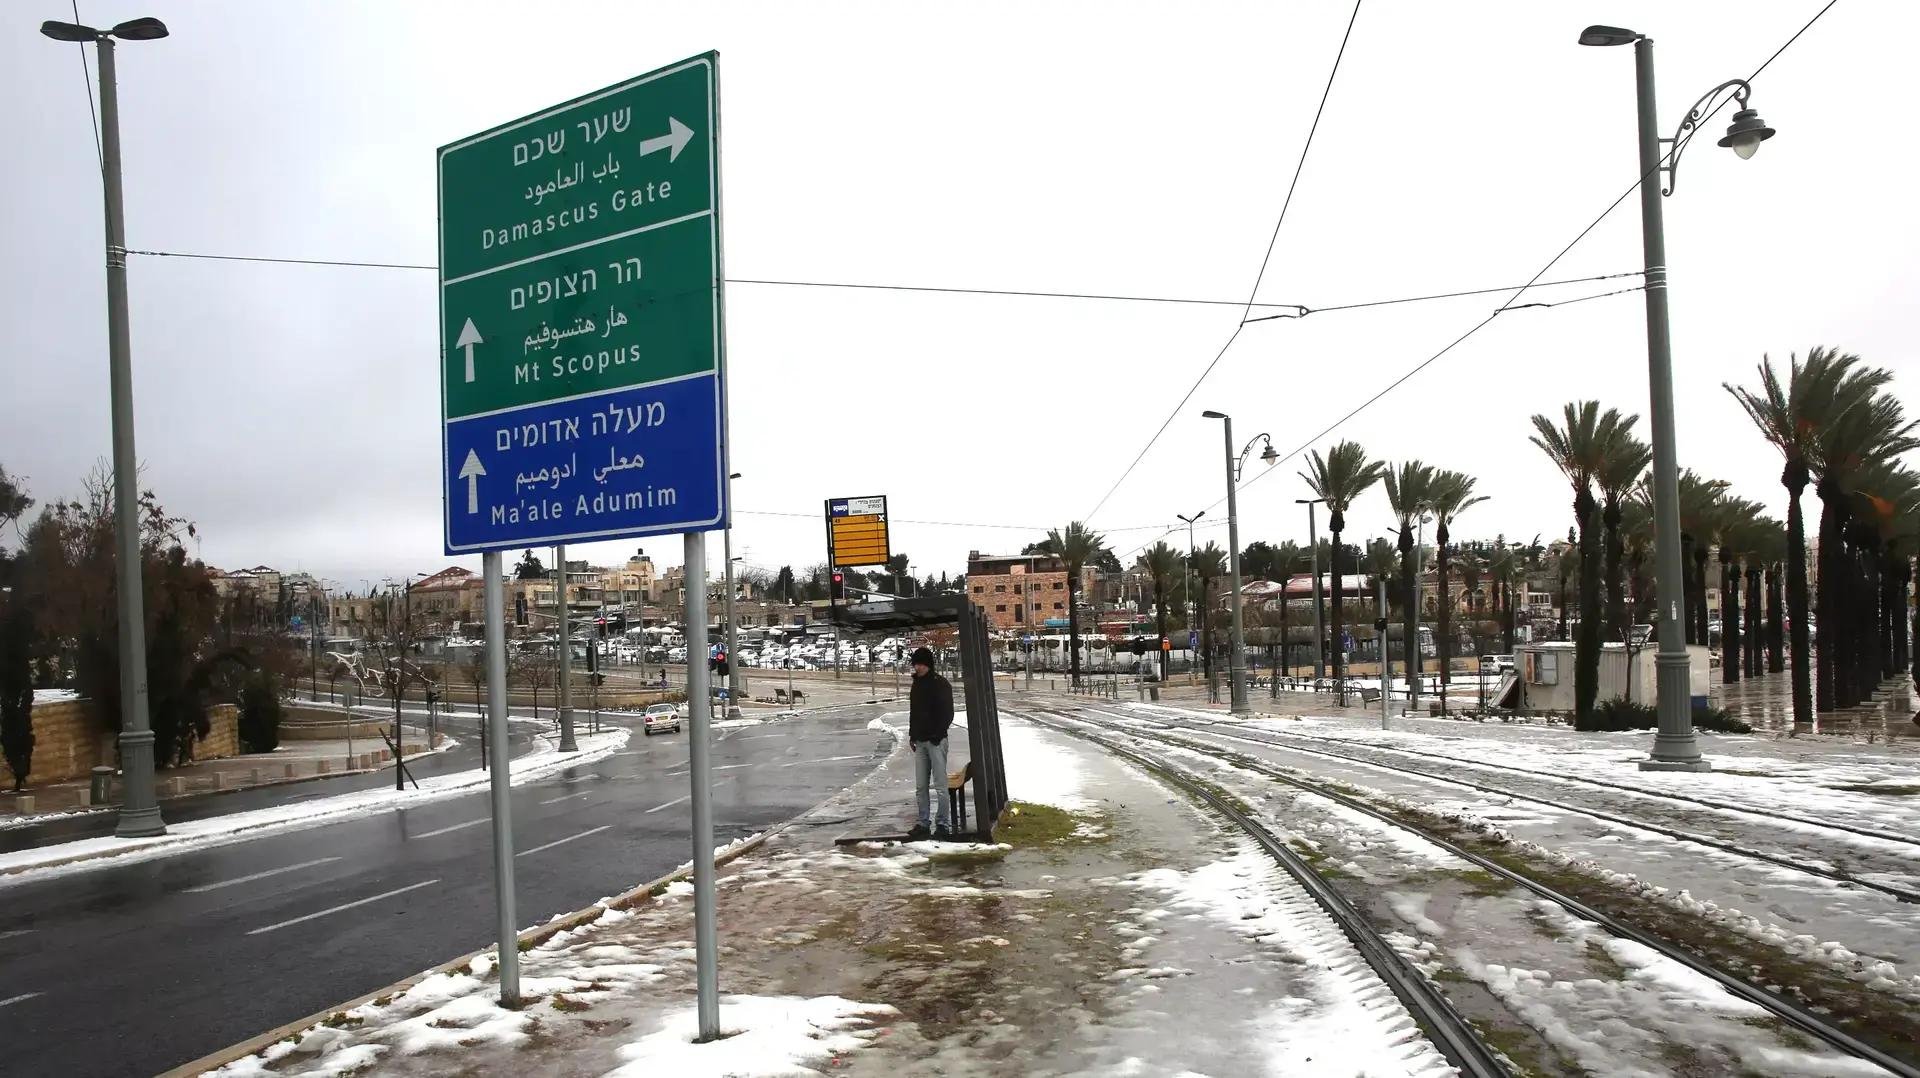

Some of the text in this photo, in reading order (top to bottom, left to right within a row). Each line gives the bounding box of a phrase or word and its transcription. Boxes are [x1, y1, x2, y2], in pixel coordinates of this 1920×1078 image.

[513, 106, 631, 167] שער שכם
[525, 152, 620, 206] باب العامود
[482, 181, 672, 250] Damascus Gate
[510, 257, 642, 311] הר הצופים
[524, 319, 596, 356] هتسوفيم
[515, 344, 641, 385] Mt Scopus
[496, 401, 666, 452] מעלה אדומים
[516, 446, 645, 495] معلي ادوميم
[491, 486, 677, 526] Ma'ale Adumim
